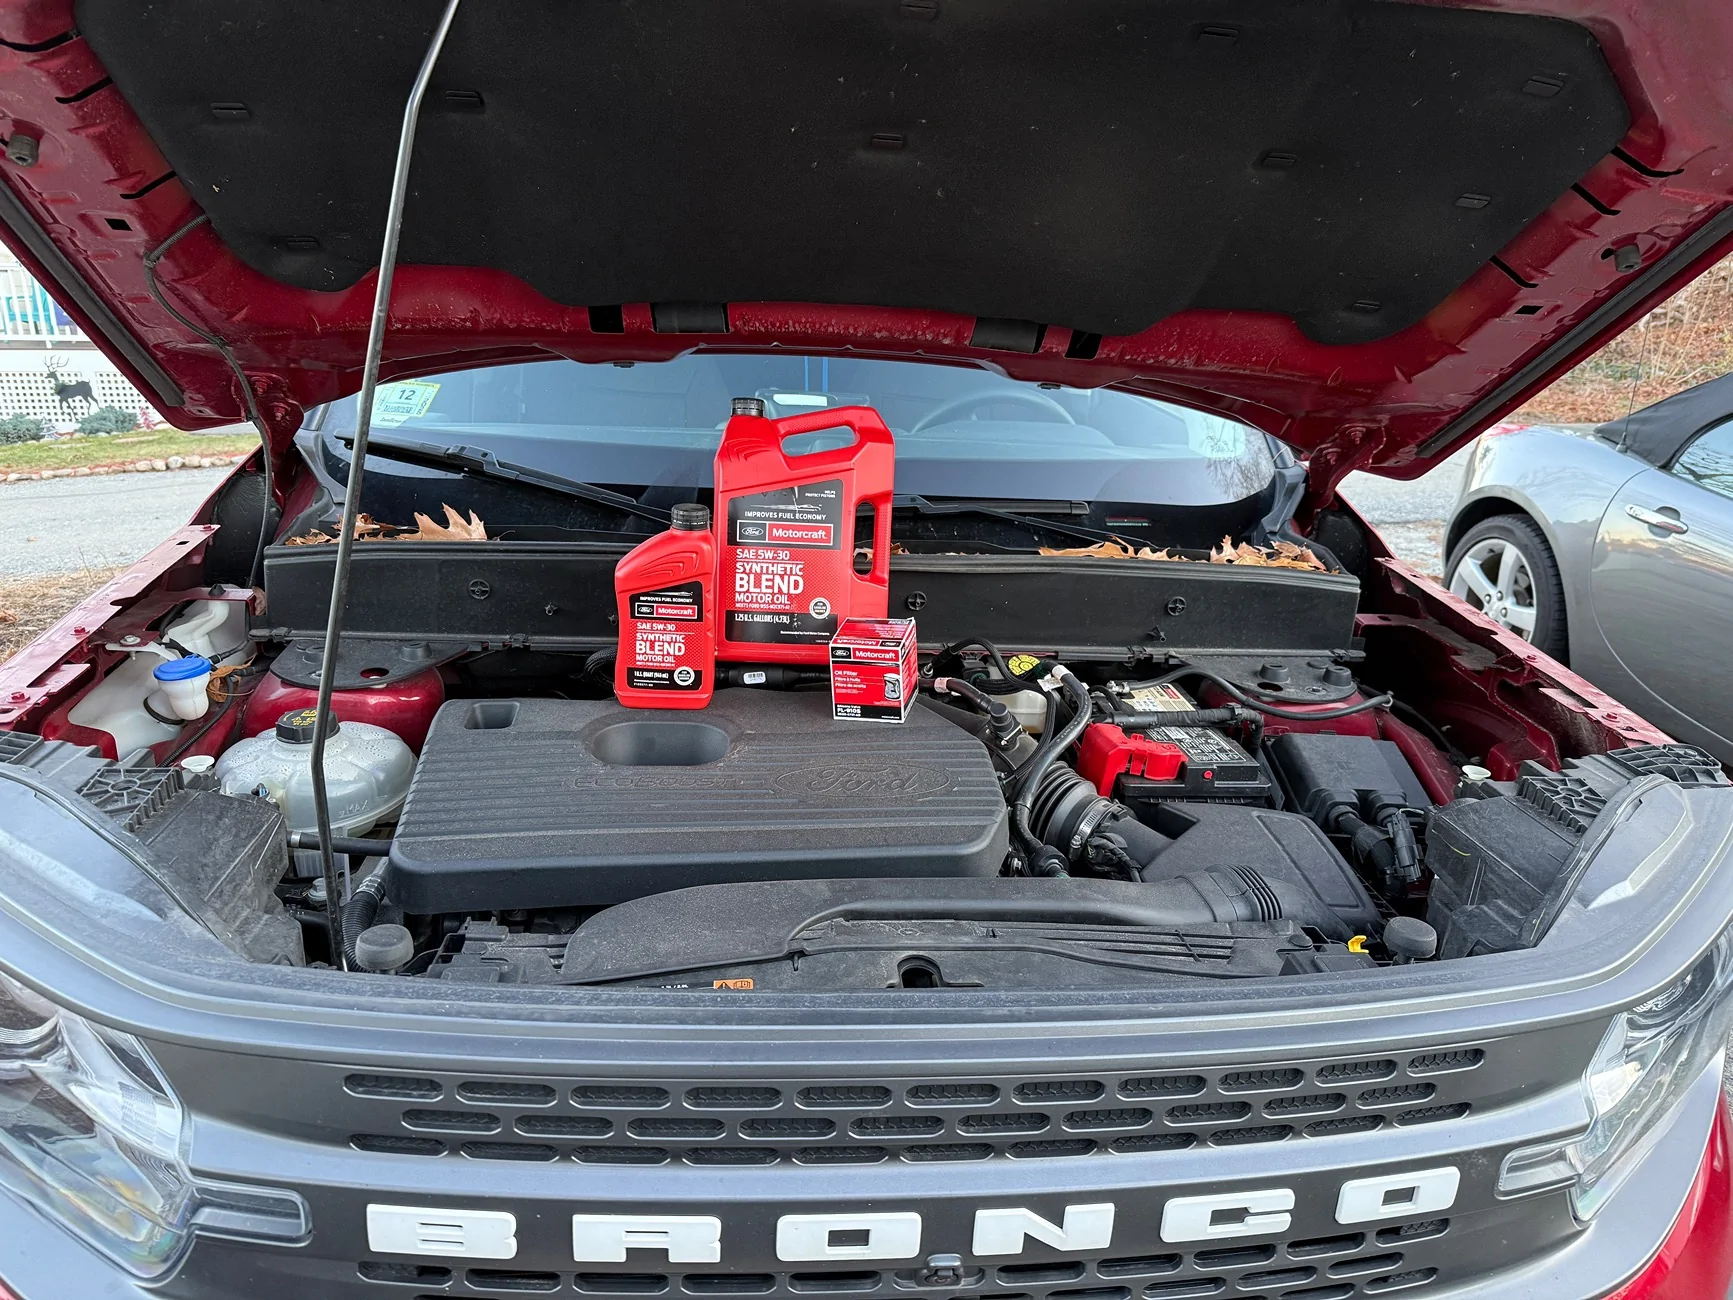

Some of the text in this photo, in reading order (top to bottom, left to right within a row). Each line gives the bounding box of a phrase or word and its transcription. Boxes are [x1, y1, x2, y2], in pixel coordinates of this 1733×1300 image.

[399, 389, 416, 401] 12
[744, 527, 761, 536] Ford
[772, 528, 827, 539] Motorcraft
[736, 549, 790, 560] SAE 5W-30
[735, 562, 804, 575] SYNTHETIC
[735, 573, 804, 595] BLEND
[735, 592, 790, 604] MOTOR OIL
[658, 607, 693, 615] Motorcraft
[636, 622, 676, 631] SAE 5W-30
[636, 632, 685, 643] SYNTHETIC
[636, 641, 685, 656] BLEND
[636, 654, 676, 663] MOTOR OIL
[855, 650, 896, 659] Motorcraft
[807, 767, 920, 793] Ford
[346, 800, 368, 814] MAX
[366, 1166, 1460, 1263] BRONCO
